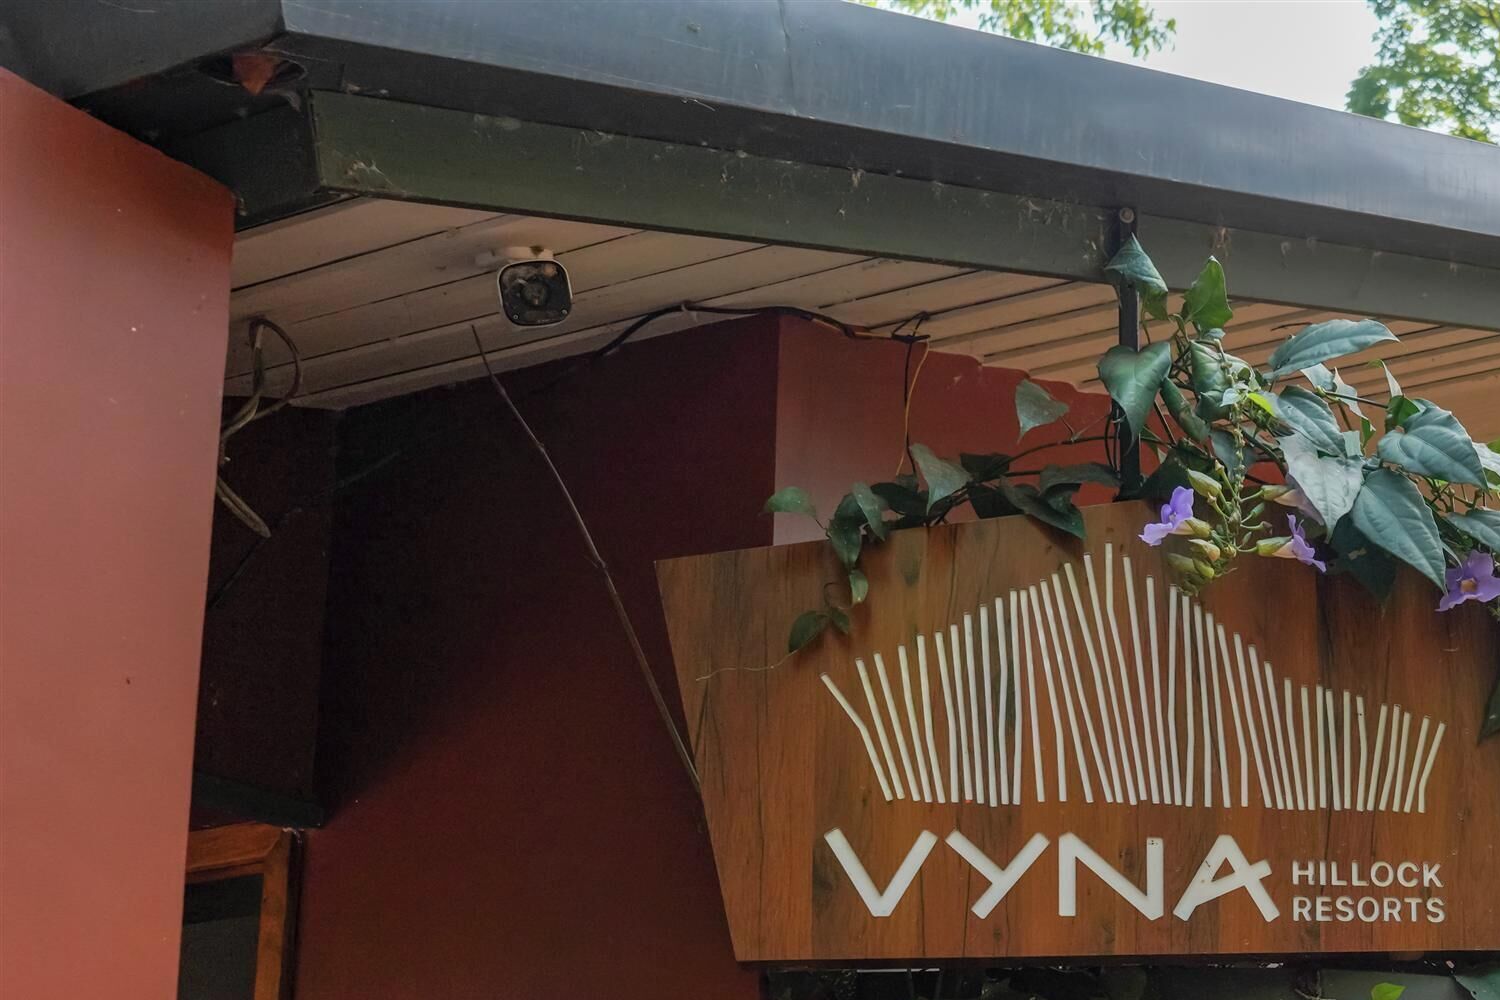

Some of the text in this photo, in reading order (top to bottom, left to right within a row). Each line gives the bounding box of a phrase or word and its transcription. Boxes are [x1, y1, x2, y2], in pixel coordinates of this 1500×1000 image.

[824, 828, 1280, 922] VYNA
[1291, 861, 1443, 888] HILLOCK
[1292, 896, 1446, 923] RESORTS
